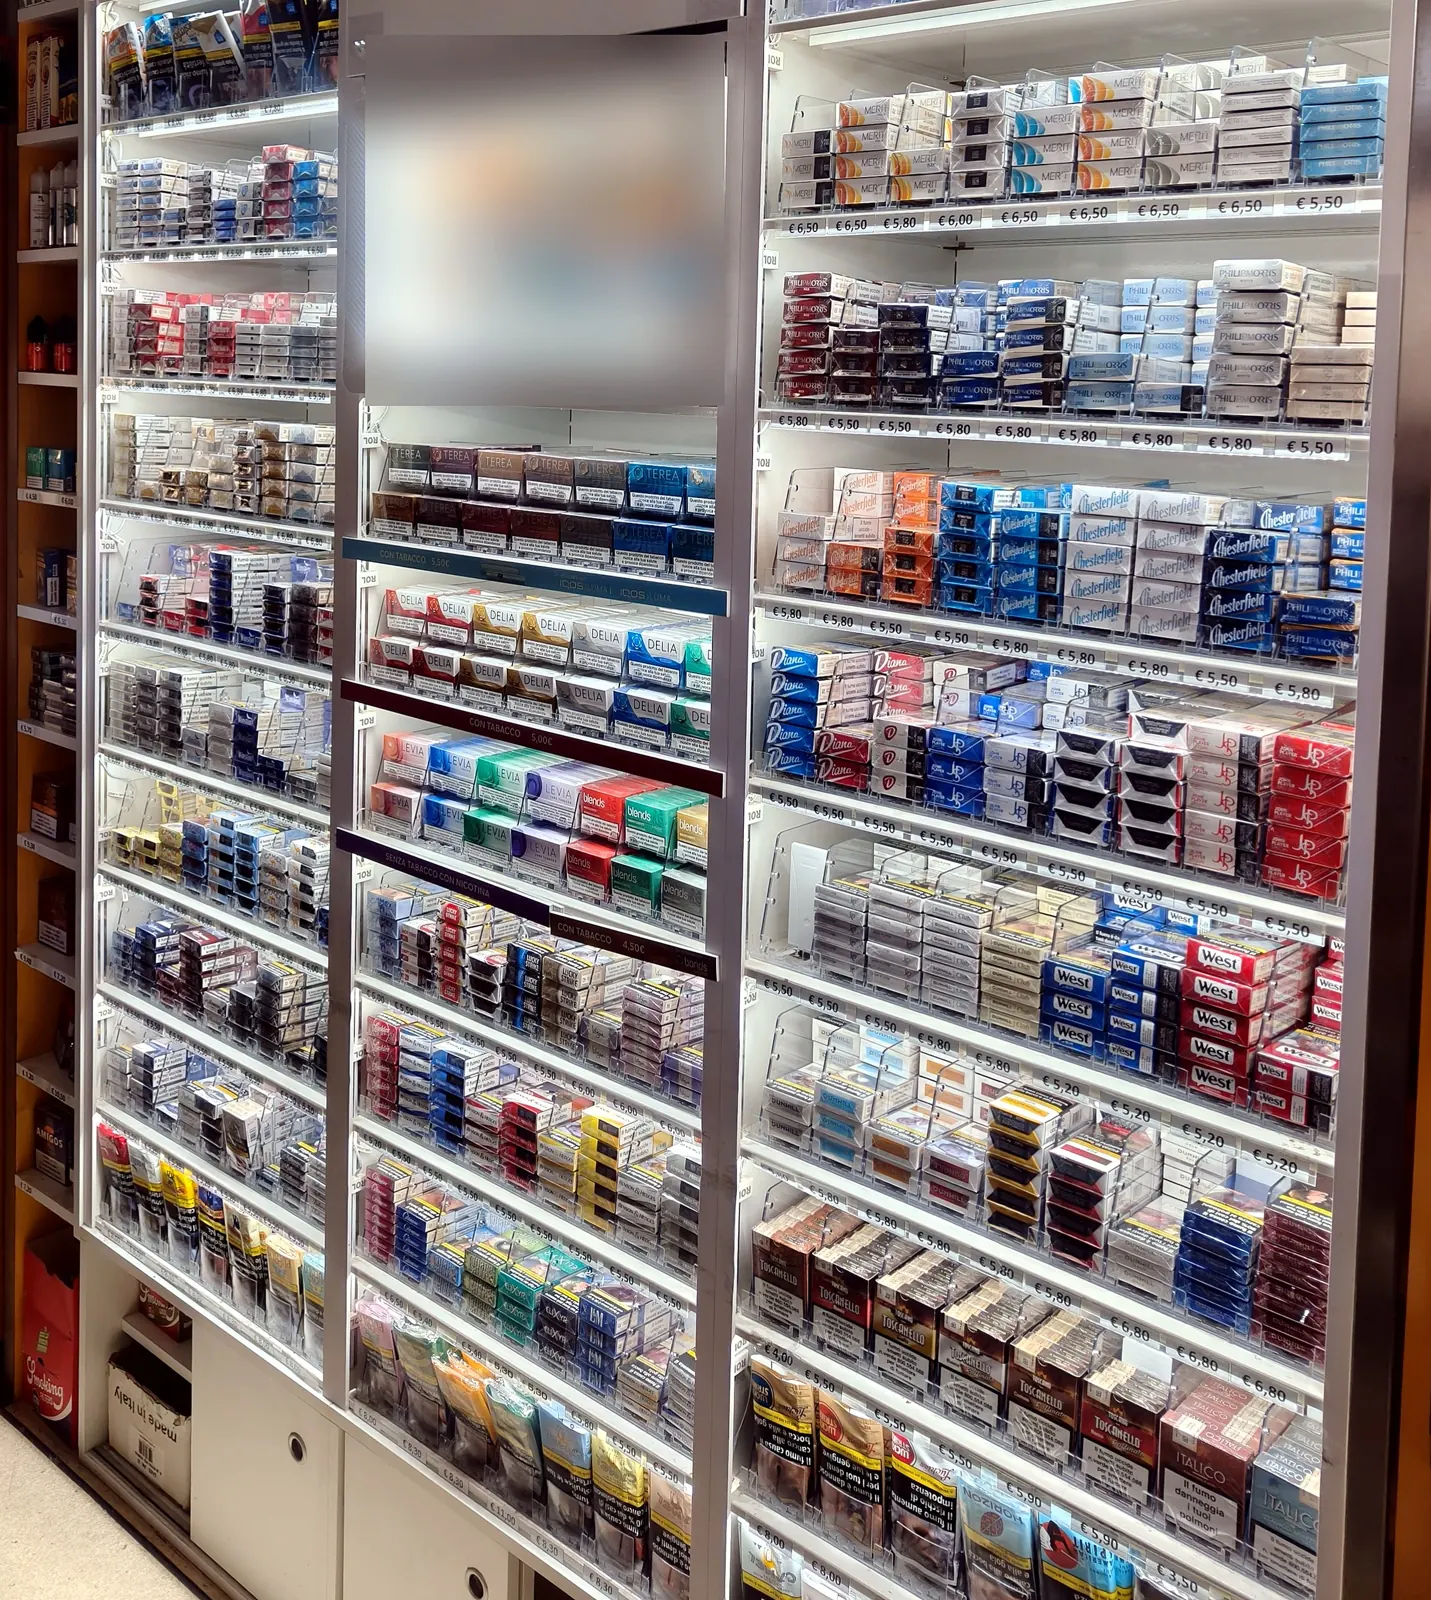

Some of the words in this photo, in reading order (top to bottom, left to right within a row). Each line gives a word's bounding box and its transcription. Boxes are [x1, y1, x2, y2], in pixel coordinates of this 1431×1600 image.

[1045, 112, 1072, 123] MERIT
[914, 180, 938, 190] MERIT
[1297, 198, 1305, 210] €
[1310, 196, 1343, 211] 5,50
[789, 223, 796, 234] €
[796, 223, 819, 235] 6,50
[938, 215, 945, 226] €
[948, 214, 973, 227] 6,00
[779, 416, 785, 425] €
[787, 416, 808, 428] 5,80
[879, 420, 885, 430] €
[888, 421, 911, 434] 5,50
[1132, 433, 1140, 445] €
[1143, 433, 1173, 448] 5,80
[396, 449, 421, 459] TEREA
[444, 450, 469, 460] TEREA
[486, 456, 512, 469] TEREA
[541, 458, 570, 471] TEREA
[648, 466, 679, 481] TEREA
[1214, 535, 1269, 558] Chesterfield
[380, 551, 395, 560] CON
[398, 553, 426, 564] TABACCO
[401, 593, 423, 607] DELIA
[442, 603, 466, 616] DELIA
[490, 609, 515, 624] DELIA
[773, 607, 779, 617] €
[781, 607, 802, 619] 5,80
[540, 618, 567, 634] DELIA
[1210, 622, 1265, 645] Chesterfield
[591, 628, 619, 643] DELIA
[935, 631, 941, 641] €
[945, 632, 968, 644] 5,50
[648, 638, 677, 654] DELIA
[771, 649, 806, 668] Diana
[875, 651, 909, 673] Diana
[1275, 682, 1282, 694] €
[1288, 685, 1320, 701] 5,80
[634, 699, 664, 716] DELIA
[469, 717, 489, 728] CON
[491, 721, 521, 738] TABACCO
[531, 732, 552, 746] 5,00€
[401, 743, 425, 757] LEVIA
[820, 733, 853, 751] Diana
[768, 747, 801, 767] Diana
[496, 769, 521, 785] LEVIA
[545, 786, 572, 802] LEVIA
[583, 792, 605, 810] blends
[628, 805, 651, 822] blends
[679, 818, 703, 836] blends
[921, 829, 927, 840] €
[930, 831, 953, 847] 5,50
[385, 852, 405, 866] SENZA
[407, 858, 438, 877] TABACCO
[439, 872, 454, 884] CON
[456, 877, 490, 898] NICOTINA
[663, 880, 688, 899] blends
[1266, 917, 1273, 929] €
[1279, 920, 1310, 937] 5,50
[558, 922, 574, 935] CON
[576, 927, 612, 945] TABACCO
[622, 940, 645, 954] 4,50€
[527, 954, 539, 965] LUCKY
[1114, 960, 1138, 975] West
[1201, 950, 1238, 970] West
[563, 967, 578, 980] LUCKY
[1058, 969, 1089, 989] West
[764, 979, 770, 989] €
[772, 981, 793, 997] 5,50
[1197, 980, 1234, 1000] West
[1112, 1016, 1135, 1030] West
[1196, 1010, 1233, 1031] West
[1057, 1025, 1089, 1044] West
[976, 1053, 982, 1063] €
[986, 1056, 1010, 1073] 5,80
[1259, 1064, 1286, 1079] West
[620, 1102, 638, 1116] 6,00
[772, 1097, 799, 1113] DUNHILL
[1112, 1099, 1119, 1112] €
[1123, 1103, 1150, 1123] 5,20
[772, 1120, 799, 1136] DUNHILL
[36, 1127, 63, 1149] AMIGOS
[1253, 1148, 1261, 1161] €
[1266, 1153, 1297, 1174] 5,20
[866, 1208, 872, 1219] €
[875, 1211, 897, 1229] 5,80
[1111, 1316, 1118, 1328] €
[1122, 1320, 1150, 1342] 6,80
[772, 1346, 793, 1366] 4,00
[27, 1356, 63, 1410] Smoking
[813, 1373, 835, 1393] 5,50
[1243, 1374, 1251, 1387] €
[1255, 1381, 1286, 1402] 6,80
[114, 1386, 134, 1409] Italy
[137, 1405, 146, 1423] in
[149, 1417, 177, 1443] made
[1095, 1416, 1140, 1448] TOSCANELLO
[785, 1450, 804, 1464] fumo
[939, 1444, 945, 1454] €
[949, 1449, 972, 1470] 5,50
[1176, 1452, 1225, 1484] ITALICO
[911, 1482, 953, 1506] impotenza
[1183, 1480, 1189, 1488] Il
[1192, 1485, 1216, 1502] fumo
[963, 1487, 1025, 1525] HORIZON
[1175, 1488, 1224, 1518] danneggia
[924, 1511, 945, 1528] fumo
[1192, 1505, 1211, 1521] tuoi
[1081, 1522, 1088, 1534] €
[1092, 1528, 1118, 1550] 5,90
[1157, 1564, 1164, 1576] €
[1168, 1570, 1198, 1593] 3,50
